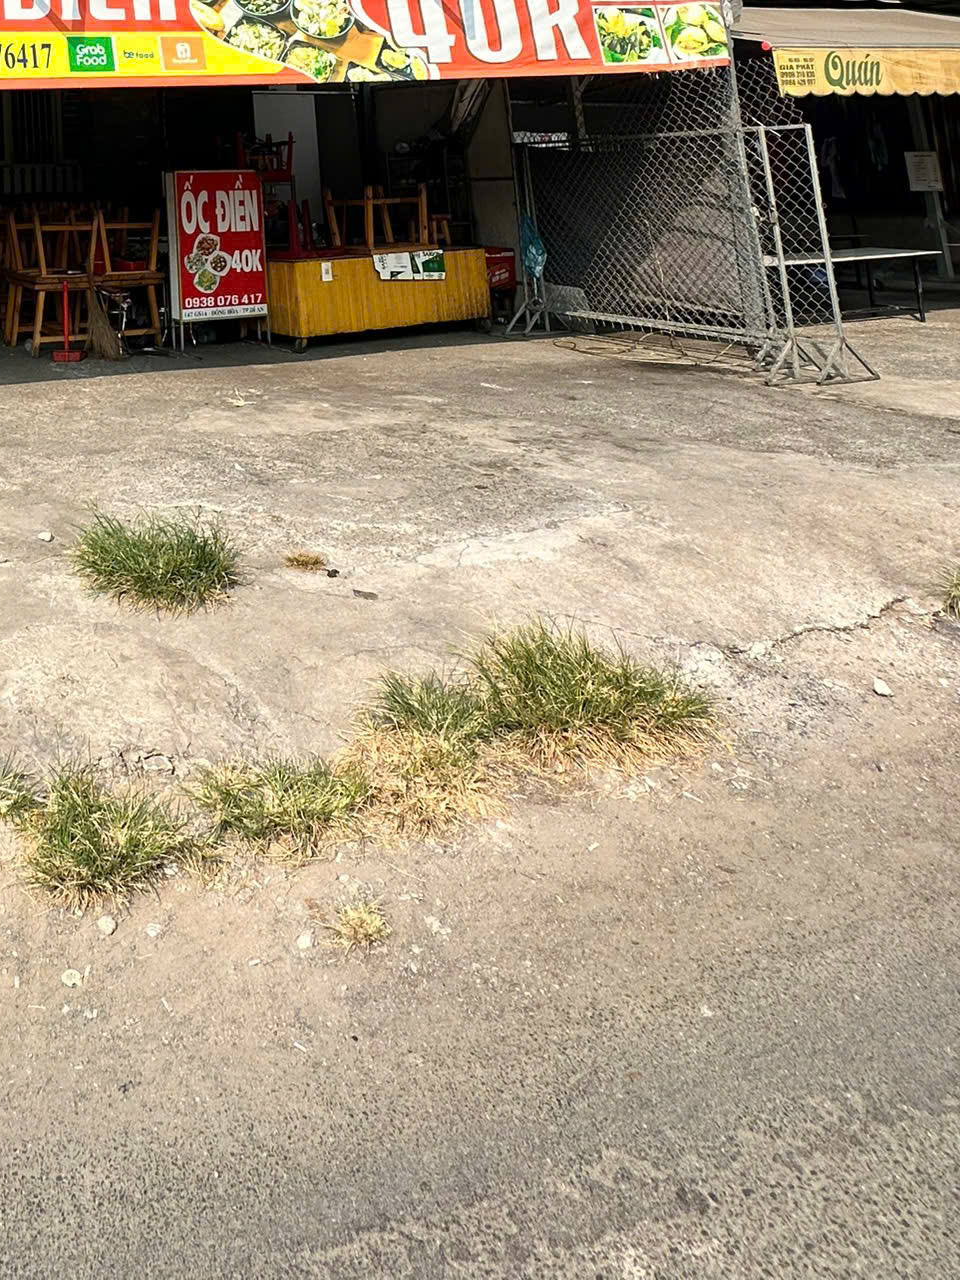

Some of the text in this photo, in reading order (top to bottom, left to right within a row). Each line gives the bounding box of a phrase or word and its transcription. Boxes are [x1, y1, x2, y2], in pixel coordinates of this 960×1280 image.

[76, 44, 105, 55] Grab
[76, 54, 108, 66] Food
[824, 51, 883, 90] Quán
[180, 174, 260, 234] ỐC ĐIỀN
[231, 249, 263, 272] 40K
[184, 293, 263, 309] 0938 076 417
